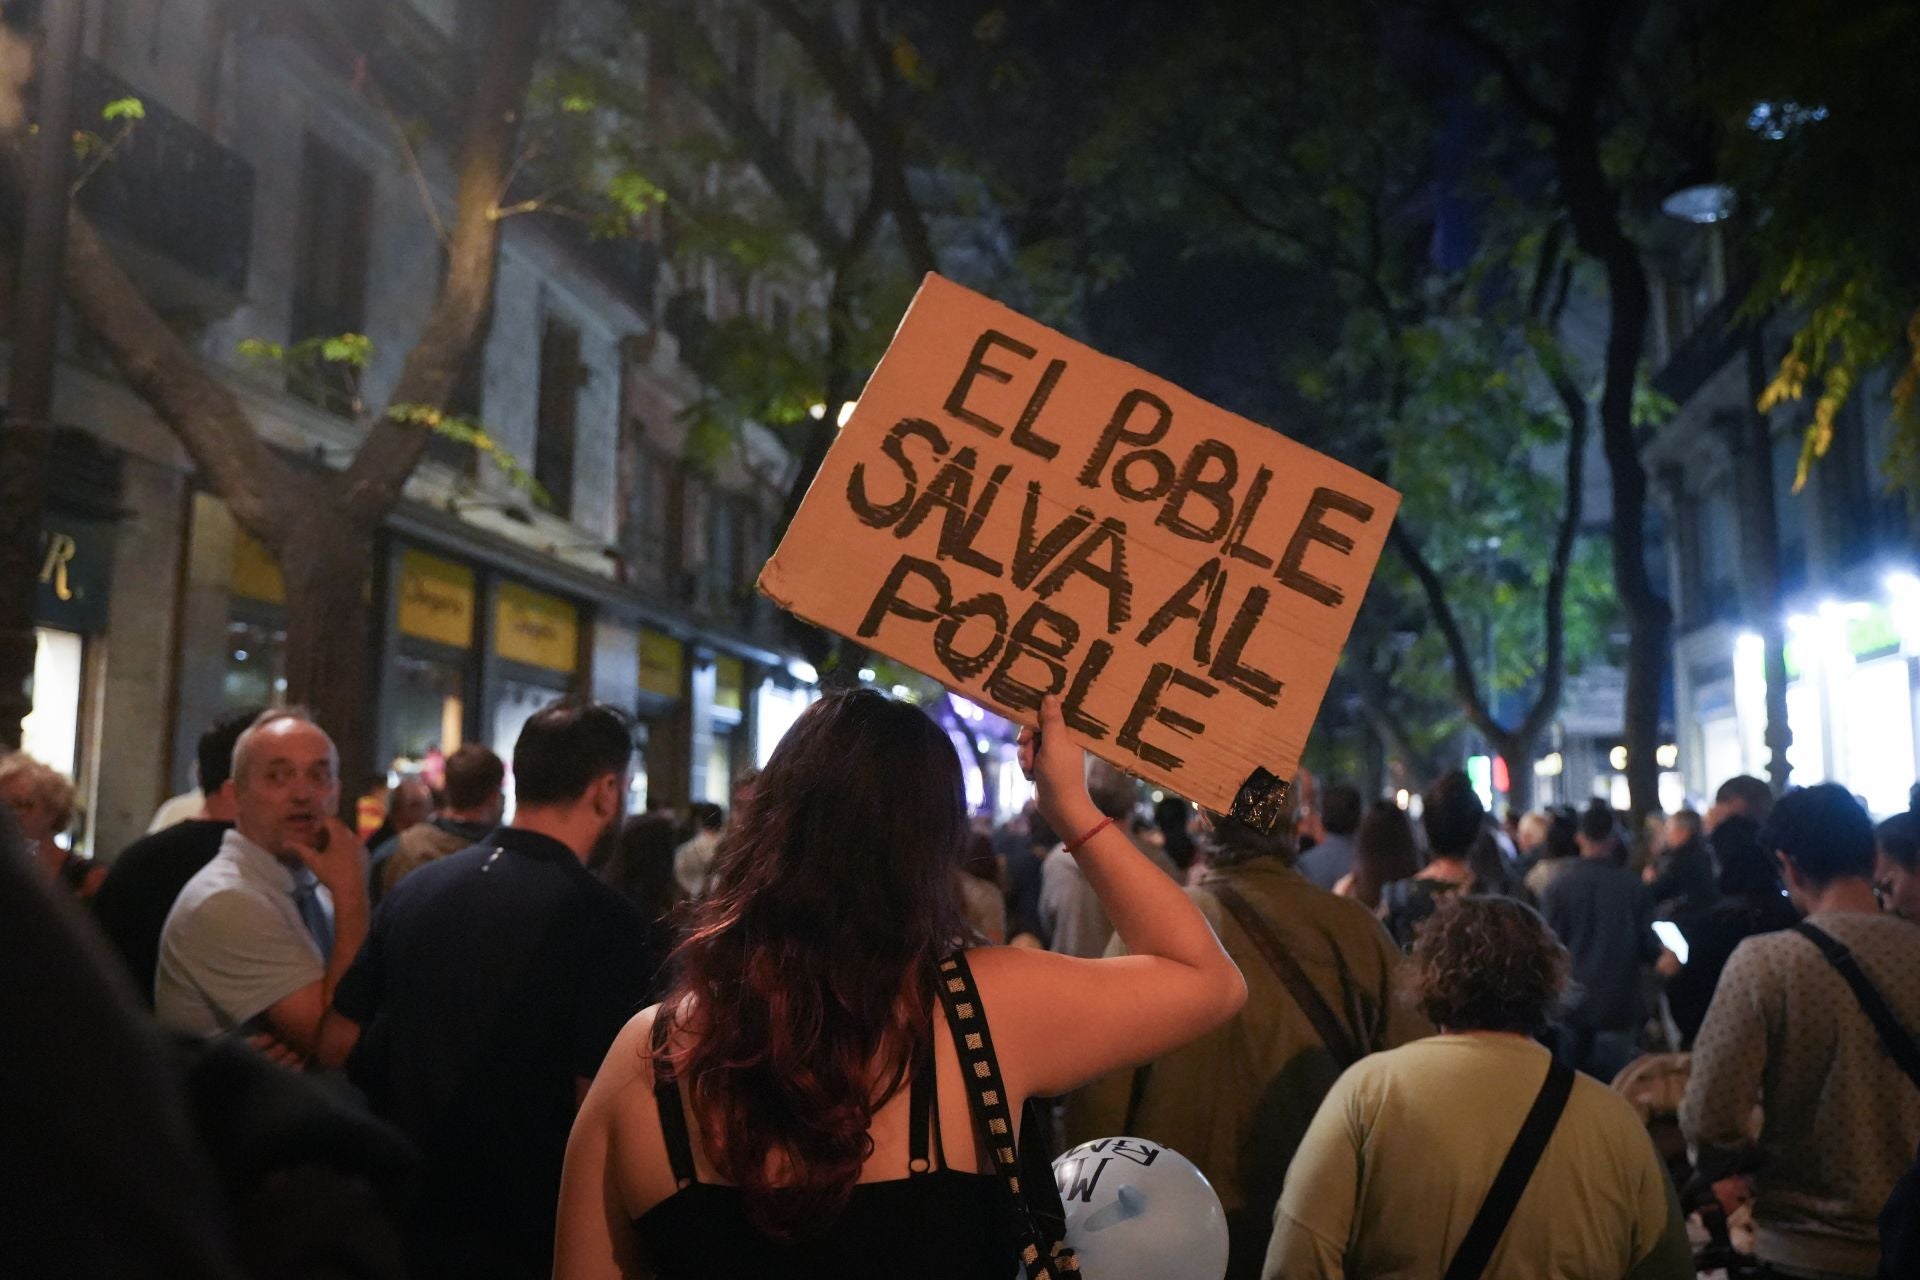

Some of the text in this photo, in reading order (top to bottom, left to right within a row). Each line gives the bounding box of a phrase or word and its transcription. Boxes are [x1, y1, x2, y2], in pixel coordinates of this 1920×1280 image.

[846, 417, 1284, 708] SALVA AL
[943, 328, 1375, 607] EL POBLE
[856, 554, 1220, 771] POBLE
